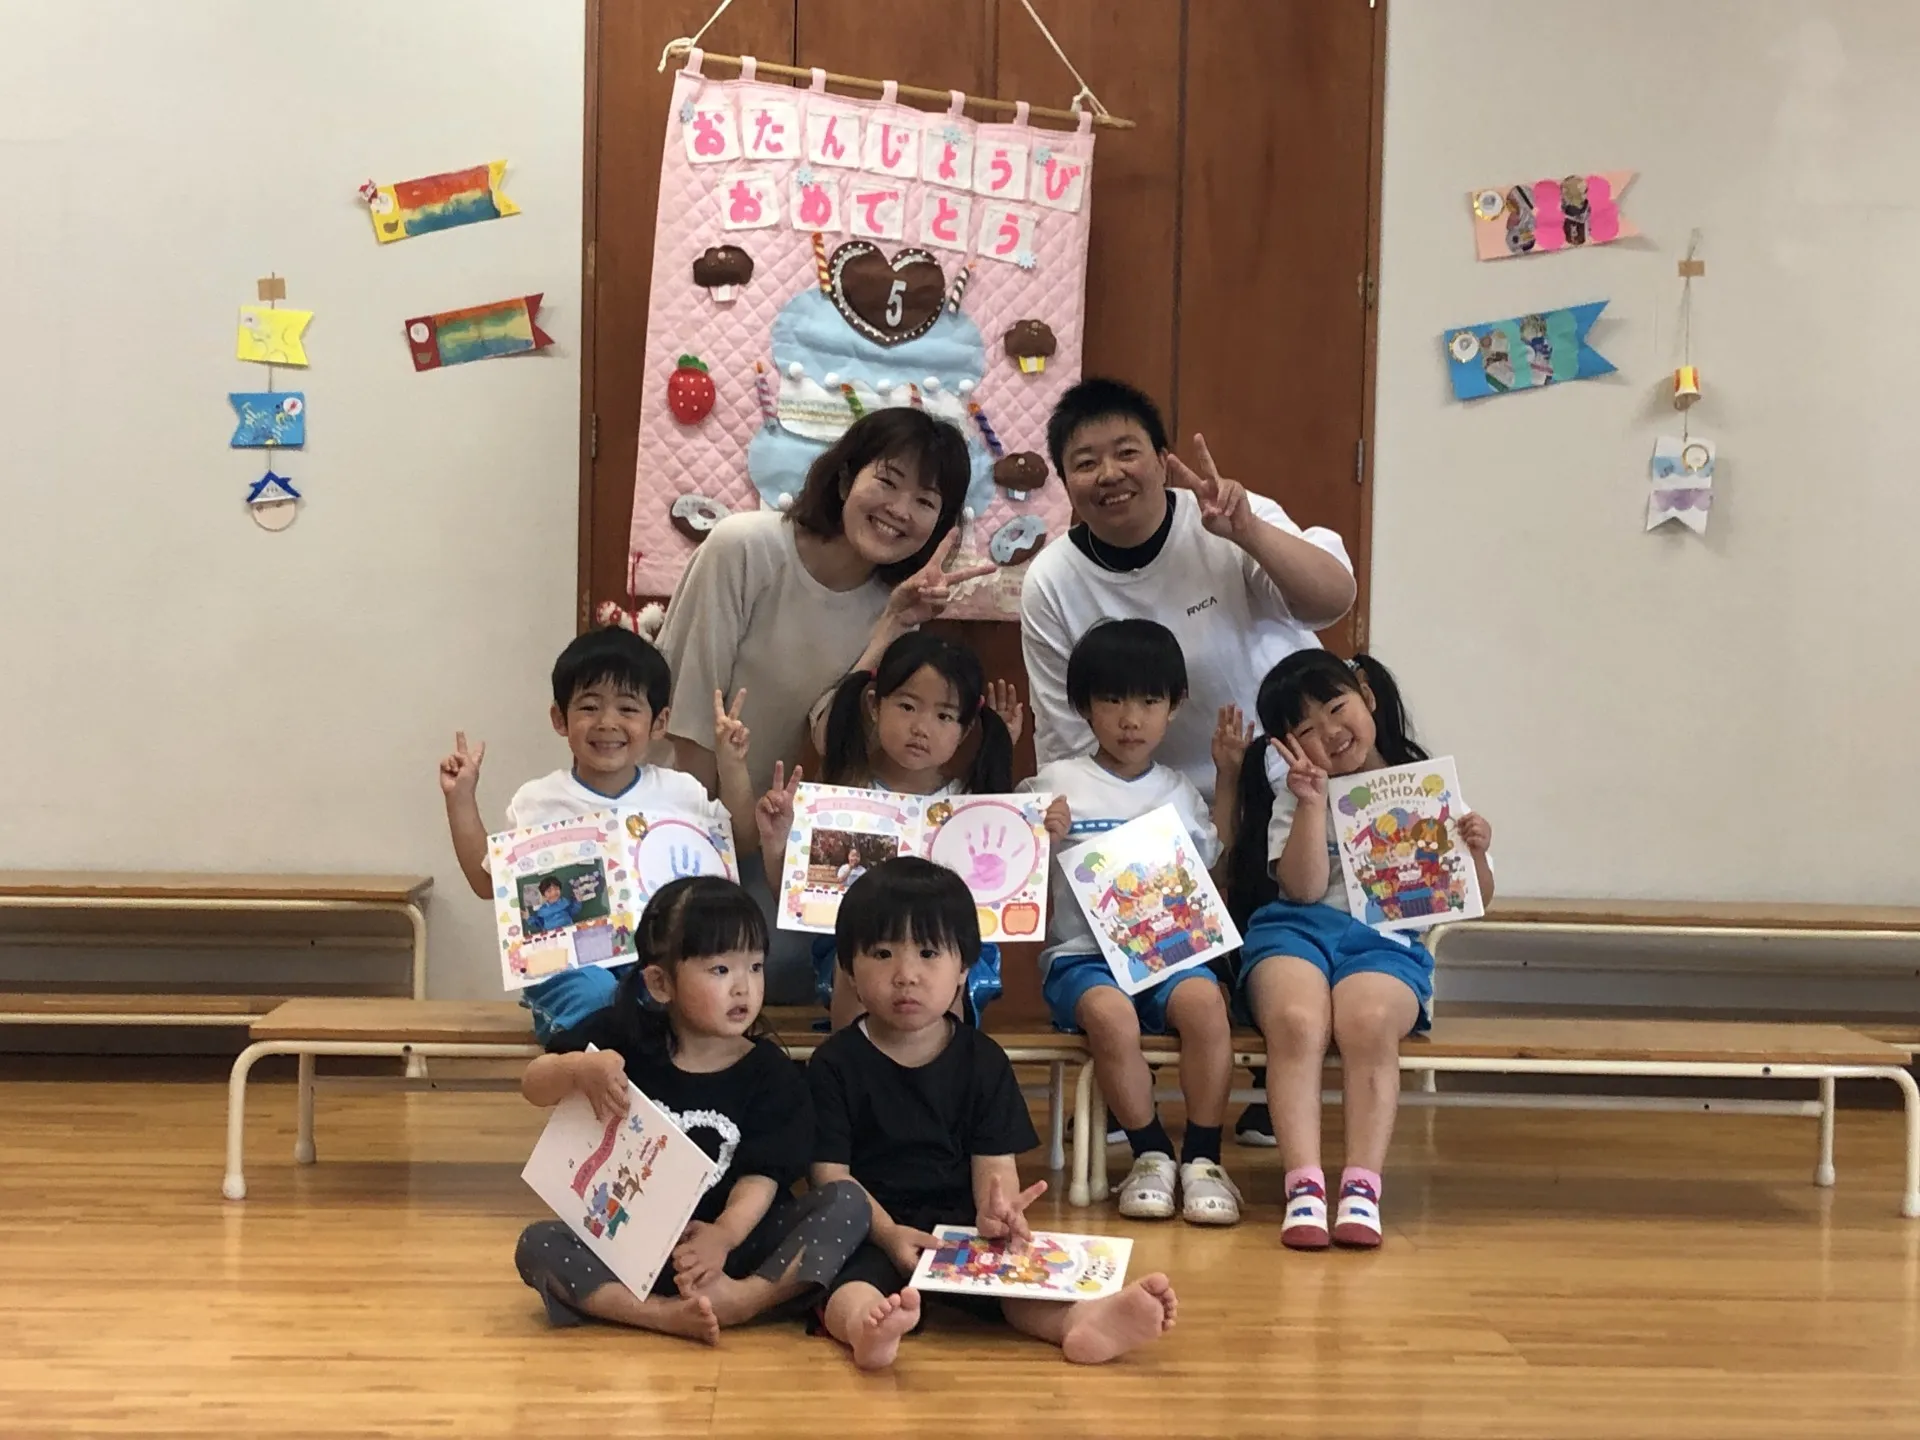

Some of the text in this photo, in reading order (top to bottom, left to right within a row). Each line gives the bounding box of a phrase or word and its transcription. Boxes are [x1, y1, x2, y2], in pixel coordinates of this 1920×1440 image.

[693, 110, 1081, 200] おたんじょうび
[729, 180, 1020, 255] おめでとう
[885, 279, 907, 327] 5
[1186, 596, 1218, 617] RVCA
[1366, 773, 1417, 790] HAPPY
[1370, 785, 1434, 803] RTHDAY
